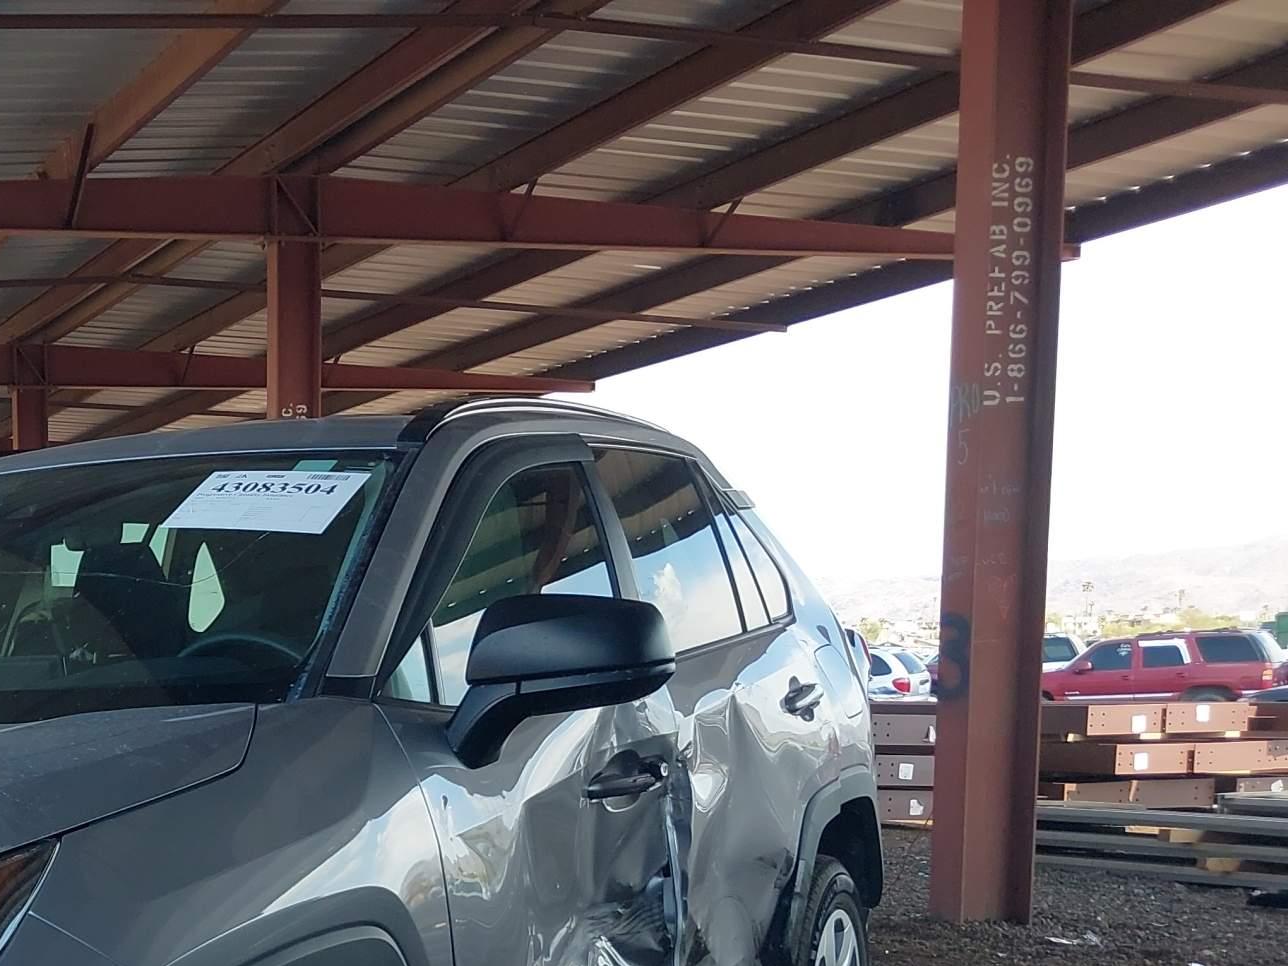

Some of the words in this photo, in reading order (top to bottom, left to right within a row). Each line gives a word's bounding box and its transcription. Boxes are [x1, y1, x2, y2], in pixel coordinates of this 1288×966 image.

[991, 154, 1011, 208] INC.
[986, 225, 1008, 335] PREFAB
[1006, 156, 1034, 404] 1-866-799-0969
[983, 353, 1004, 406] U.S.
[213, 481, 338, 495] 43083504
